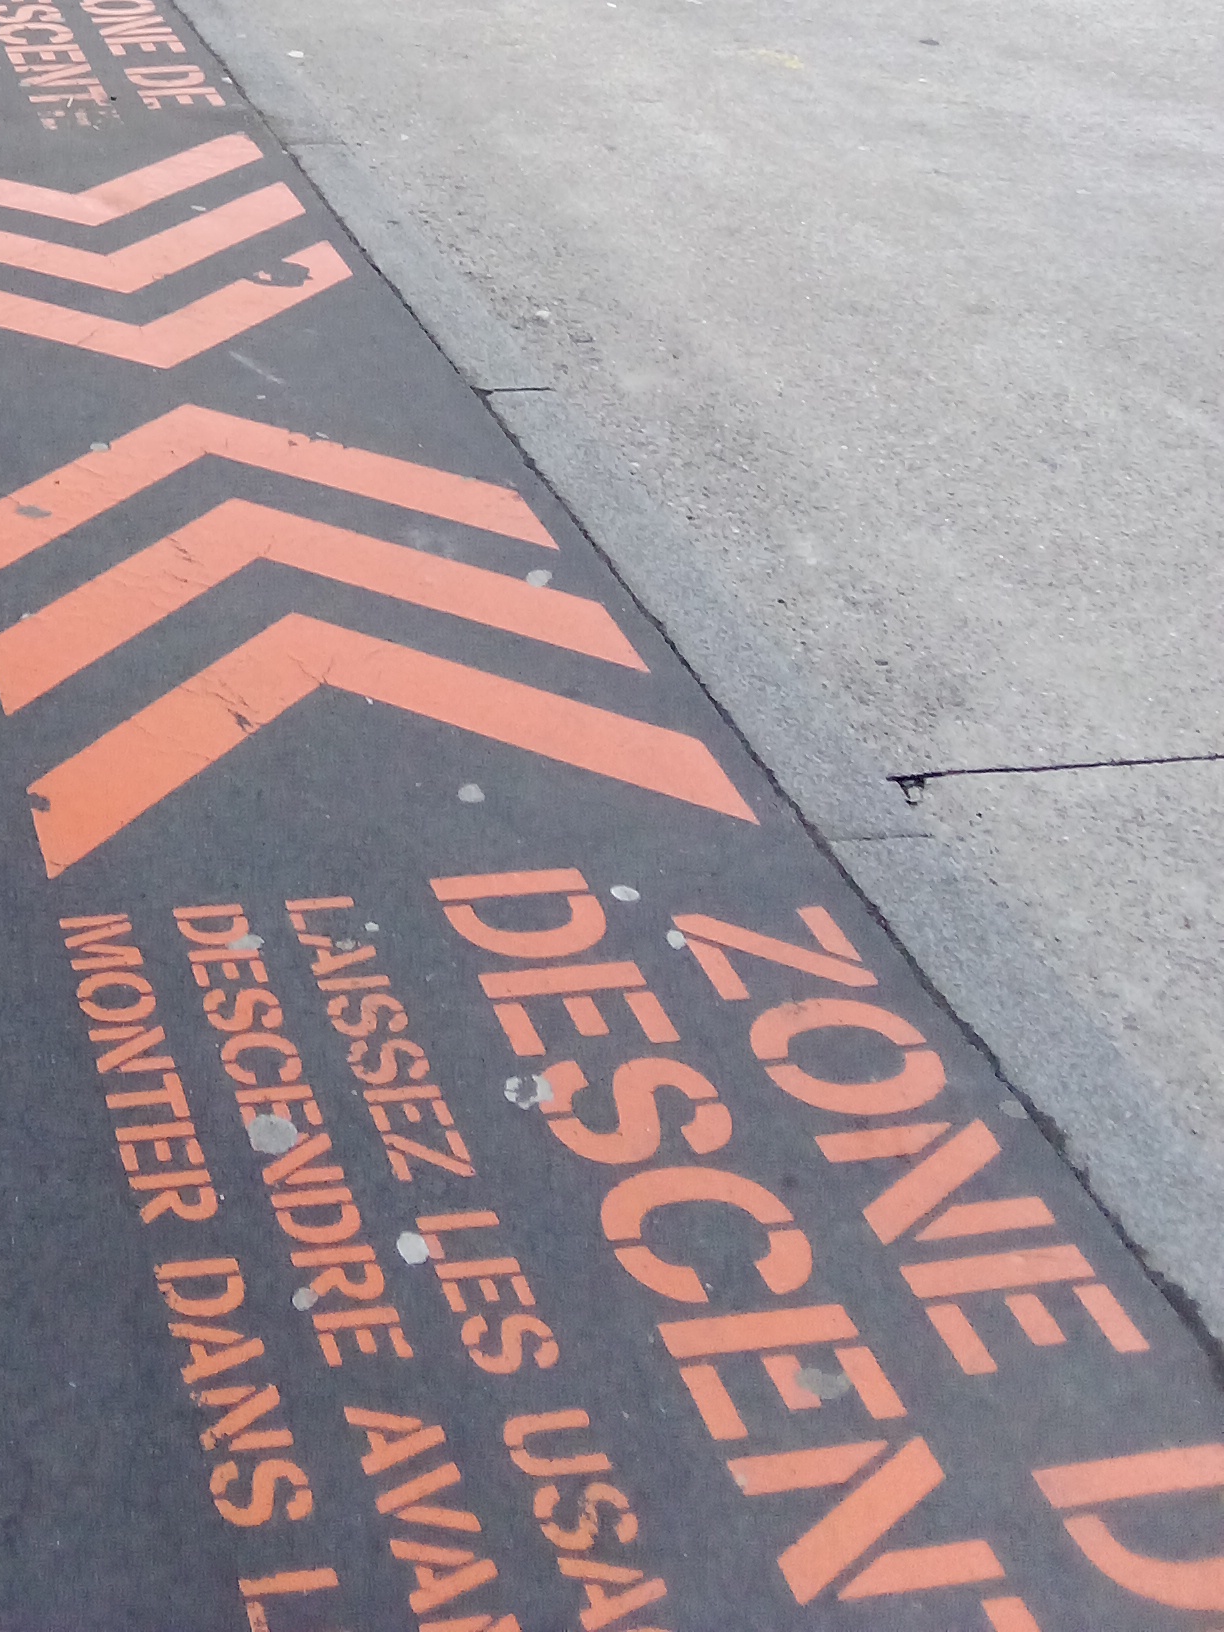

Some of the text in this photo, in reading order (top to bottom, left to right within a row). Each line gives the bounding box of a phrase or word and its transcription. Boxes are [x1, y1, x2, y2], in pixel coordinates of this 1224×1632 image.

[124, 65, 226, 110] DE
[59, 913, 218, 1224] MONTER
[153, 1257, 314, 1527] DANS
[173, 904, 414, 1367] DESCENDRE
[285, 895, 668, 1632] LAISSEZ LES USA
[429, 867, 1042, 1632] DESCEN
[671, 906, 1148, 1376] ZONE
